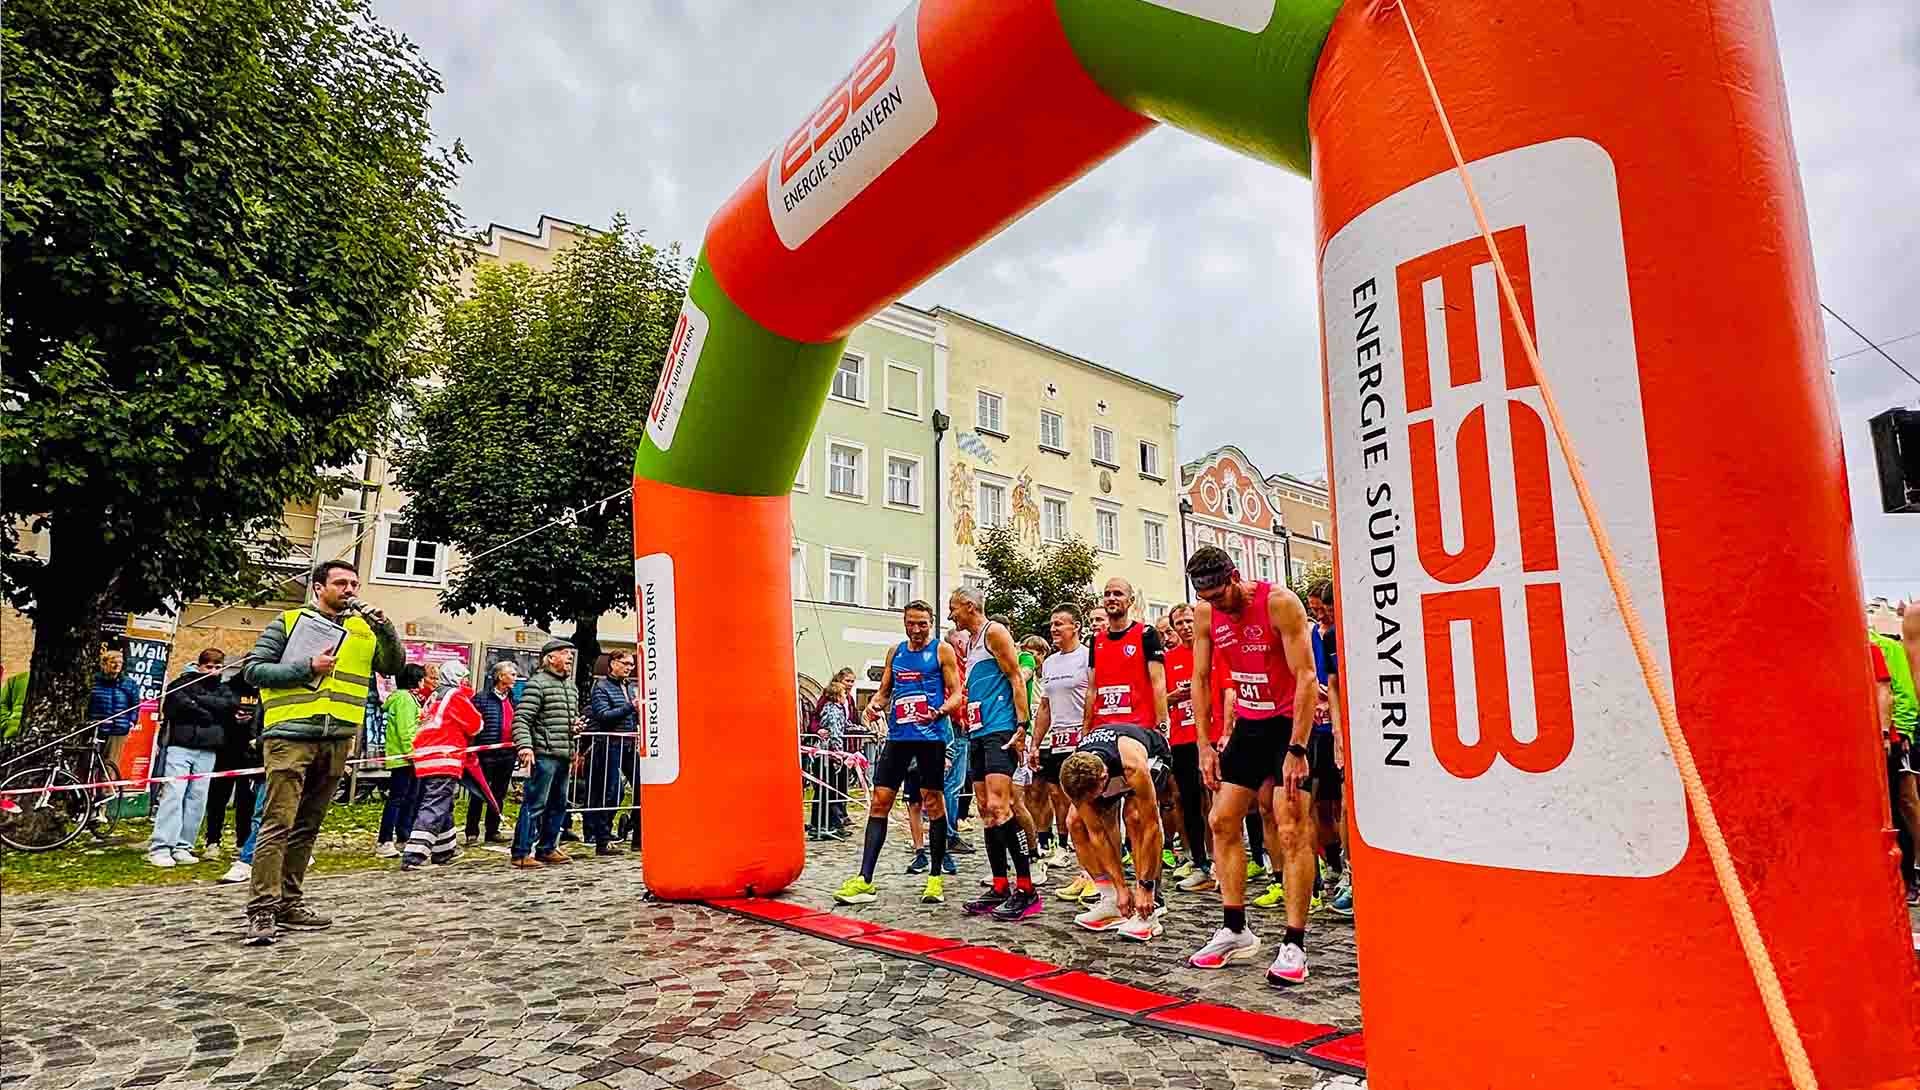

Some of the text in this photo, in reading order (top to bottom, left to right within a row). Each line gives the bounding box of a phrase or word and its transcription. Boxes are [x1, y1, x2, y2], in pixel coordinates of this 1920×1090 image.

[783, 85, 903, 212] ENERGIE SÜDBAYERN
[657, 389, 674, 431] ENERGIE
[1395, 223, 1576, 779] ESB
[1352, 276, 1411, 768] ENERGIE SÜDBAYERN
[129, 642, 167, 661] Walk
[135, 660, 153, 674] of
[1103, 692, 1122, 705] 287
[1240, 684, 1260, 700] 641
[648, 687, 659, 758] ENERGIE
[903, 704, 916, 714] 95
